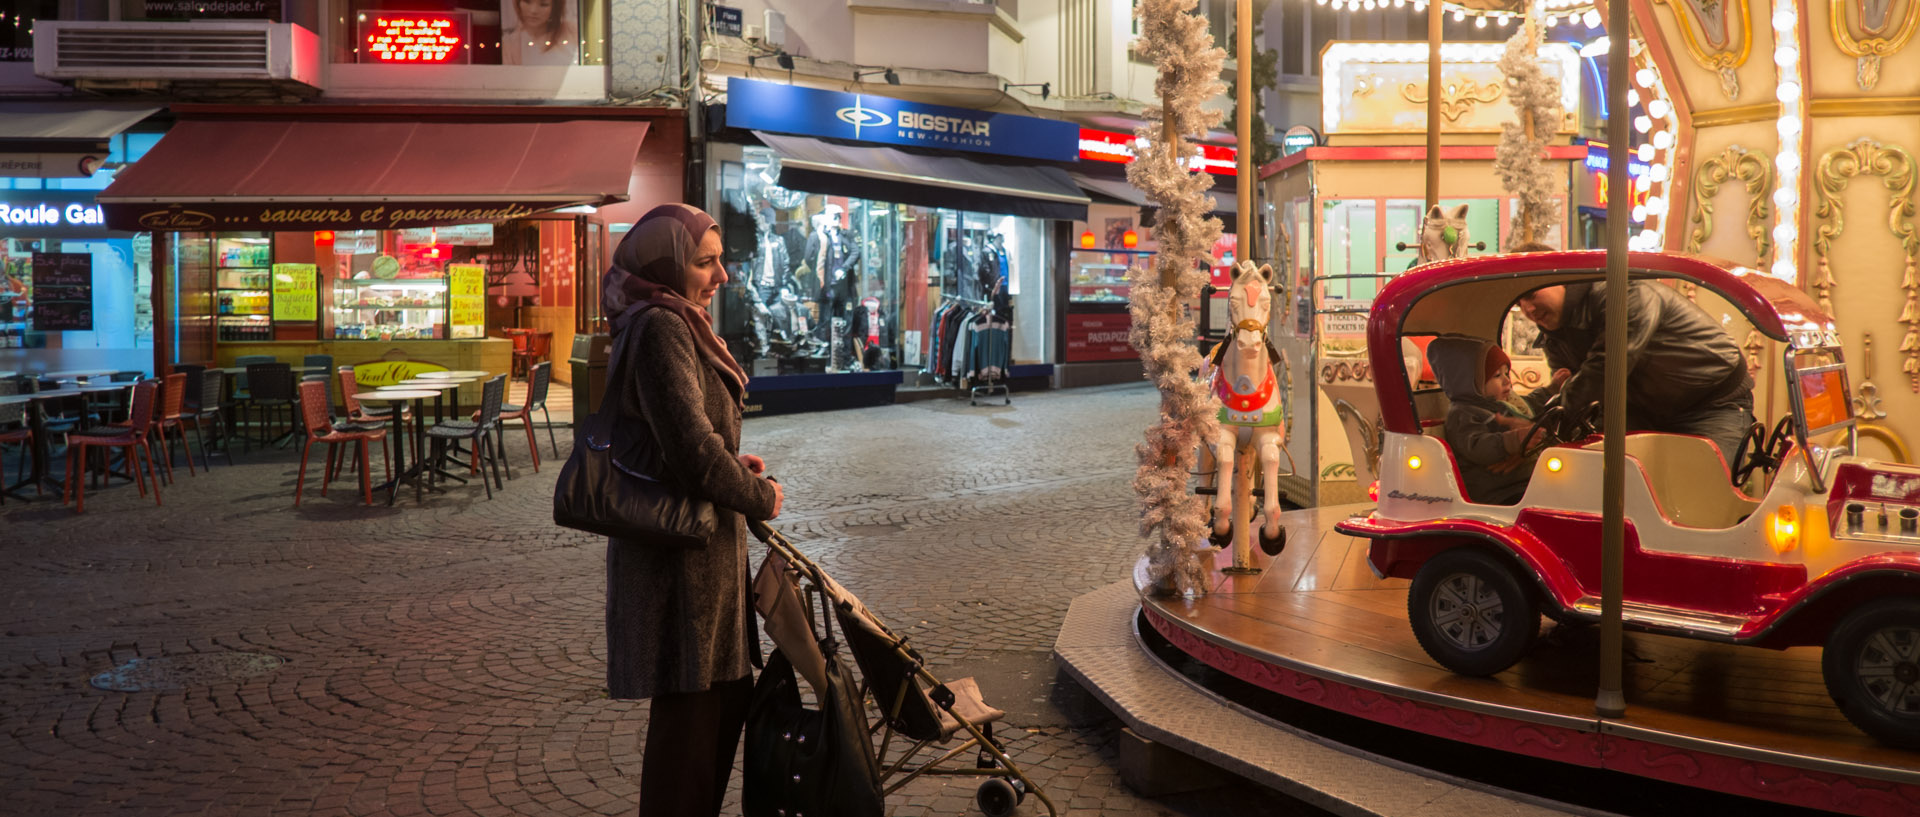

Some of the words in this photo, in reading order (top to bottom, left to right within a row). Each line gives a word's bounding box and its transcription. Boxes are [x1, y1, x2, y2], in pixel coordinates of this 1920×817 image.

[144, 0, 266, 13] www.salondejade.fr
[898, 110, 990, 137] BIGSTAR
[260, 208, 352, 223] saveurs
[360, 206, 385, 223] et
[473, 285, 479, 294] €
[357, 369, 388, 382] Tout
